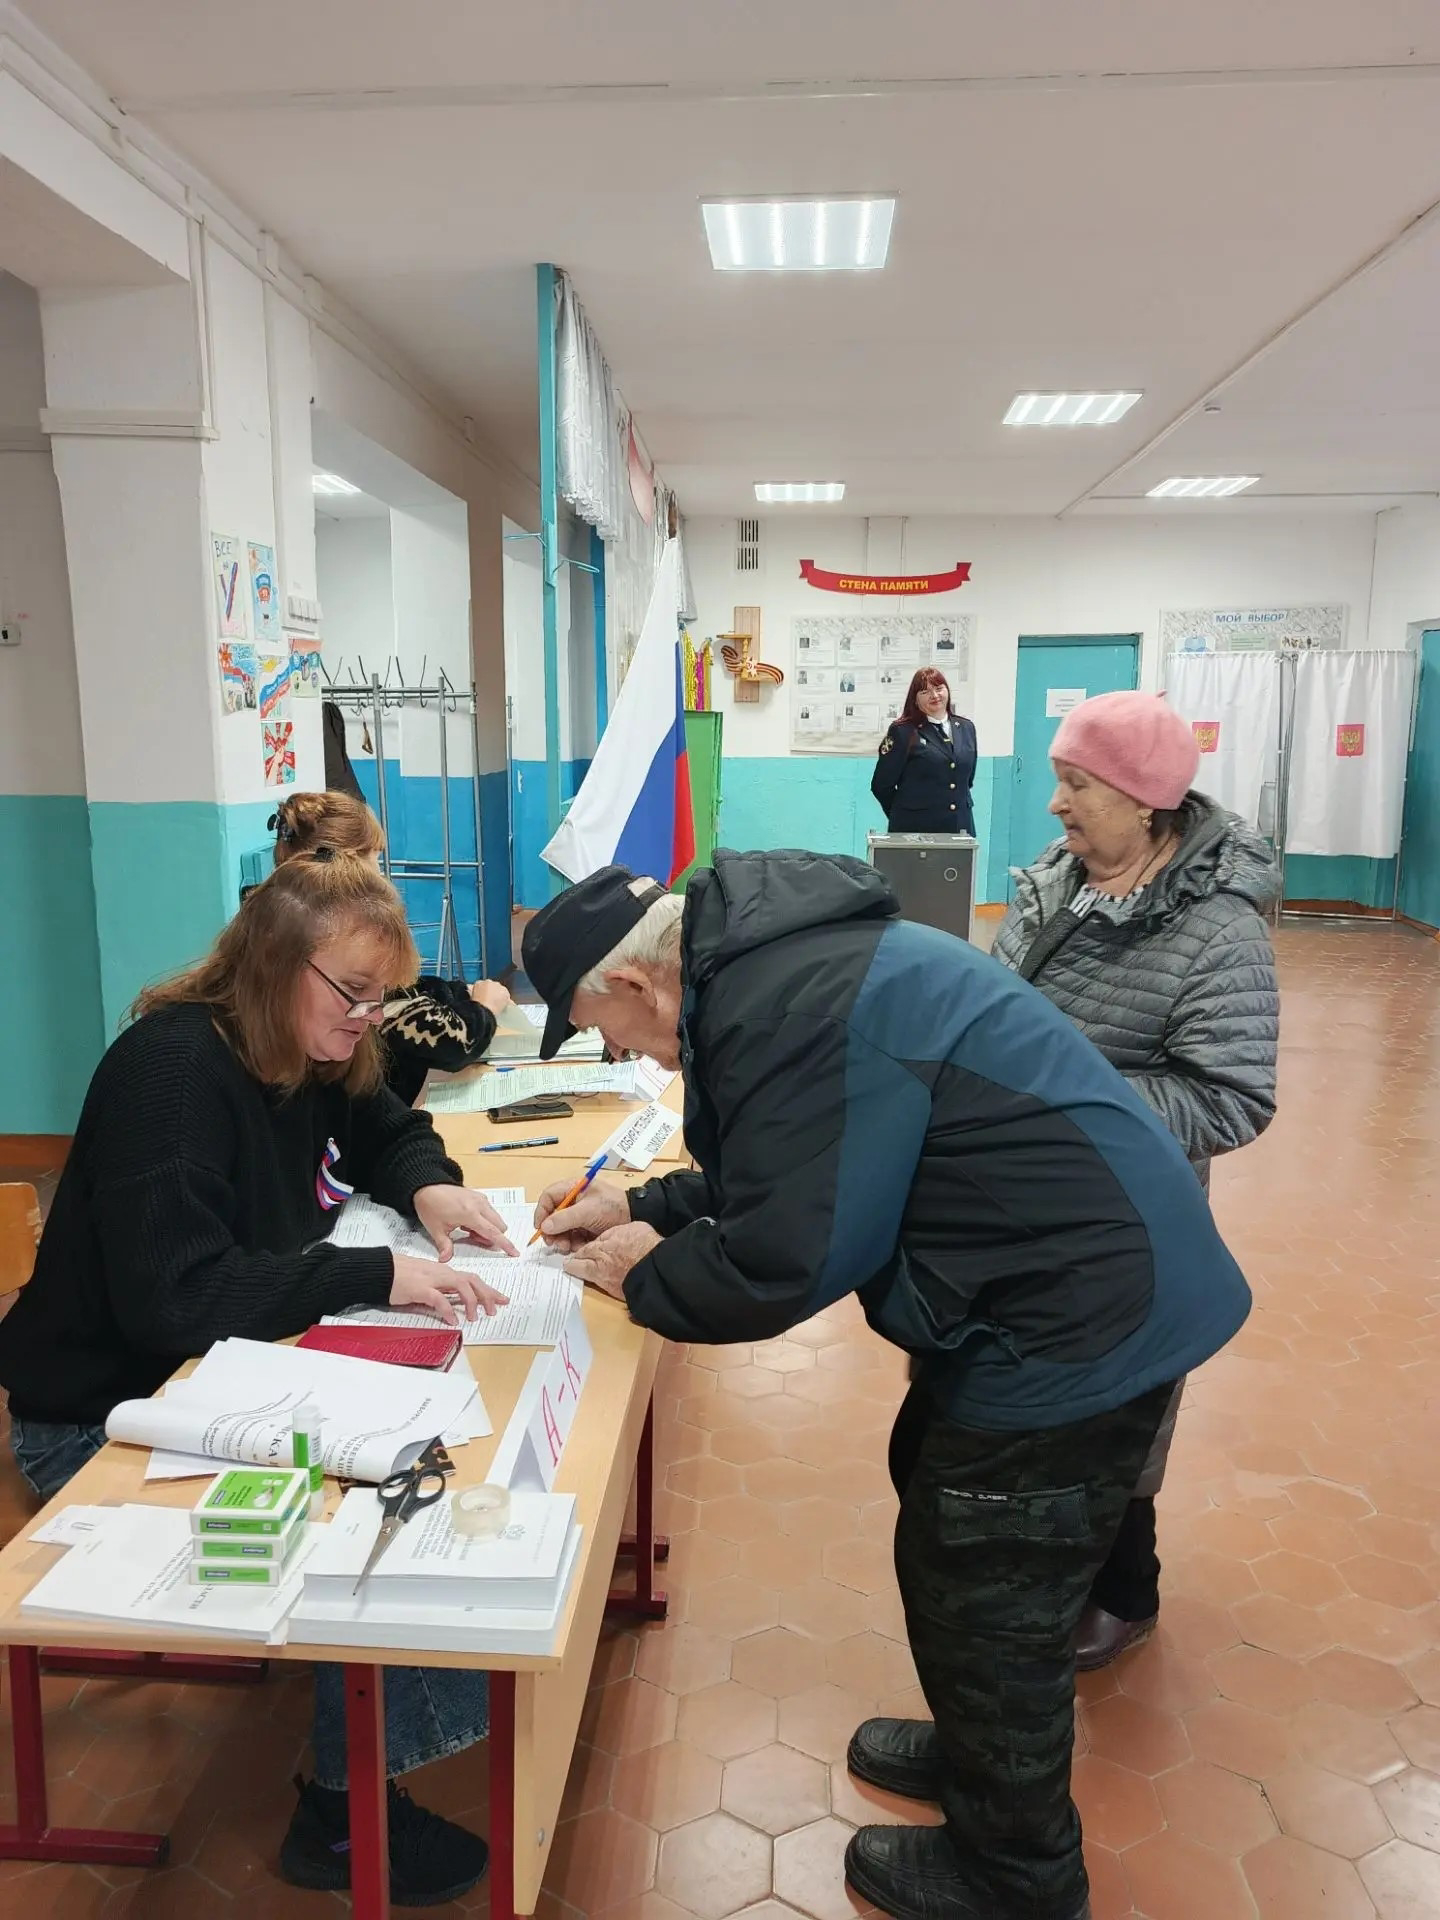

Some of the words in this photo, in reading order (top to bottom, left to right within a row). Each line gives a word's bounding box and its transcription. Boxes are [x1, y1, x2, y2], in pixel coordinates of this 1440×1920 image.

[839, 579, 877, 590] СТЕНА
[880, 580, 929, 591] ПАМЯТИ
[1215, 612, 1242, 623] МОЙ
[617, 1105, 659, 1153] ИЗБИРАТЕЛЬНАЯ
